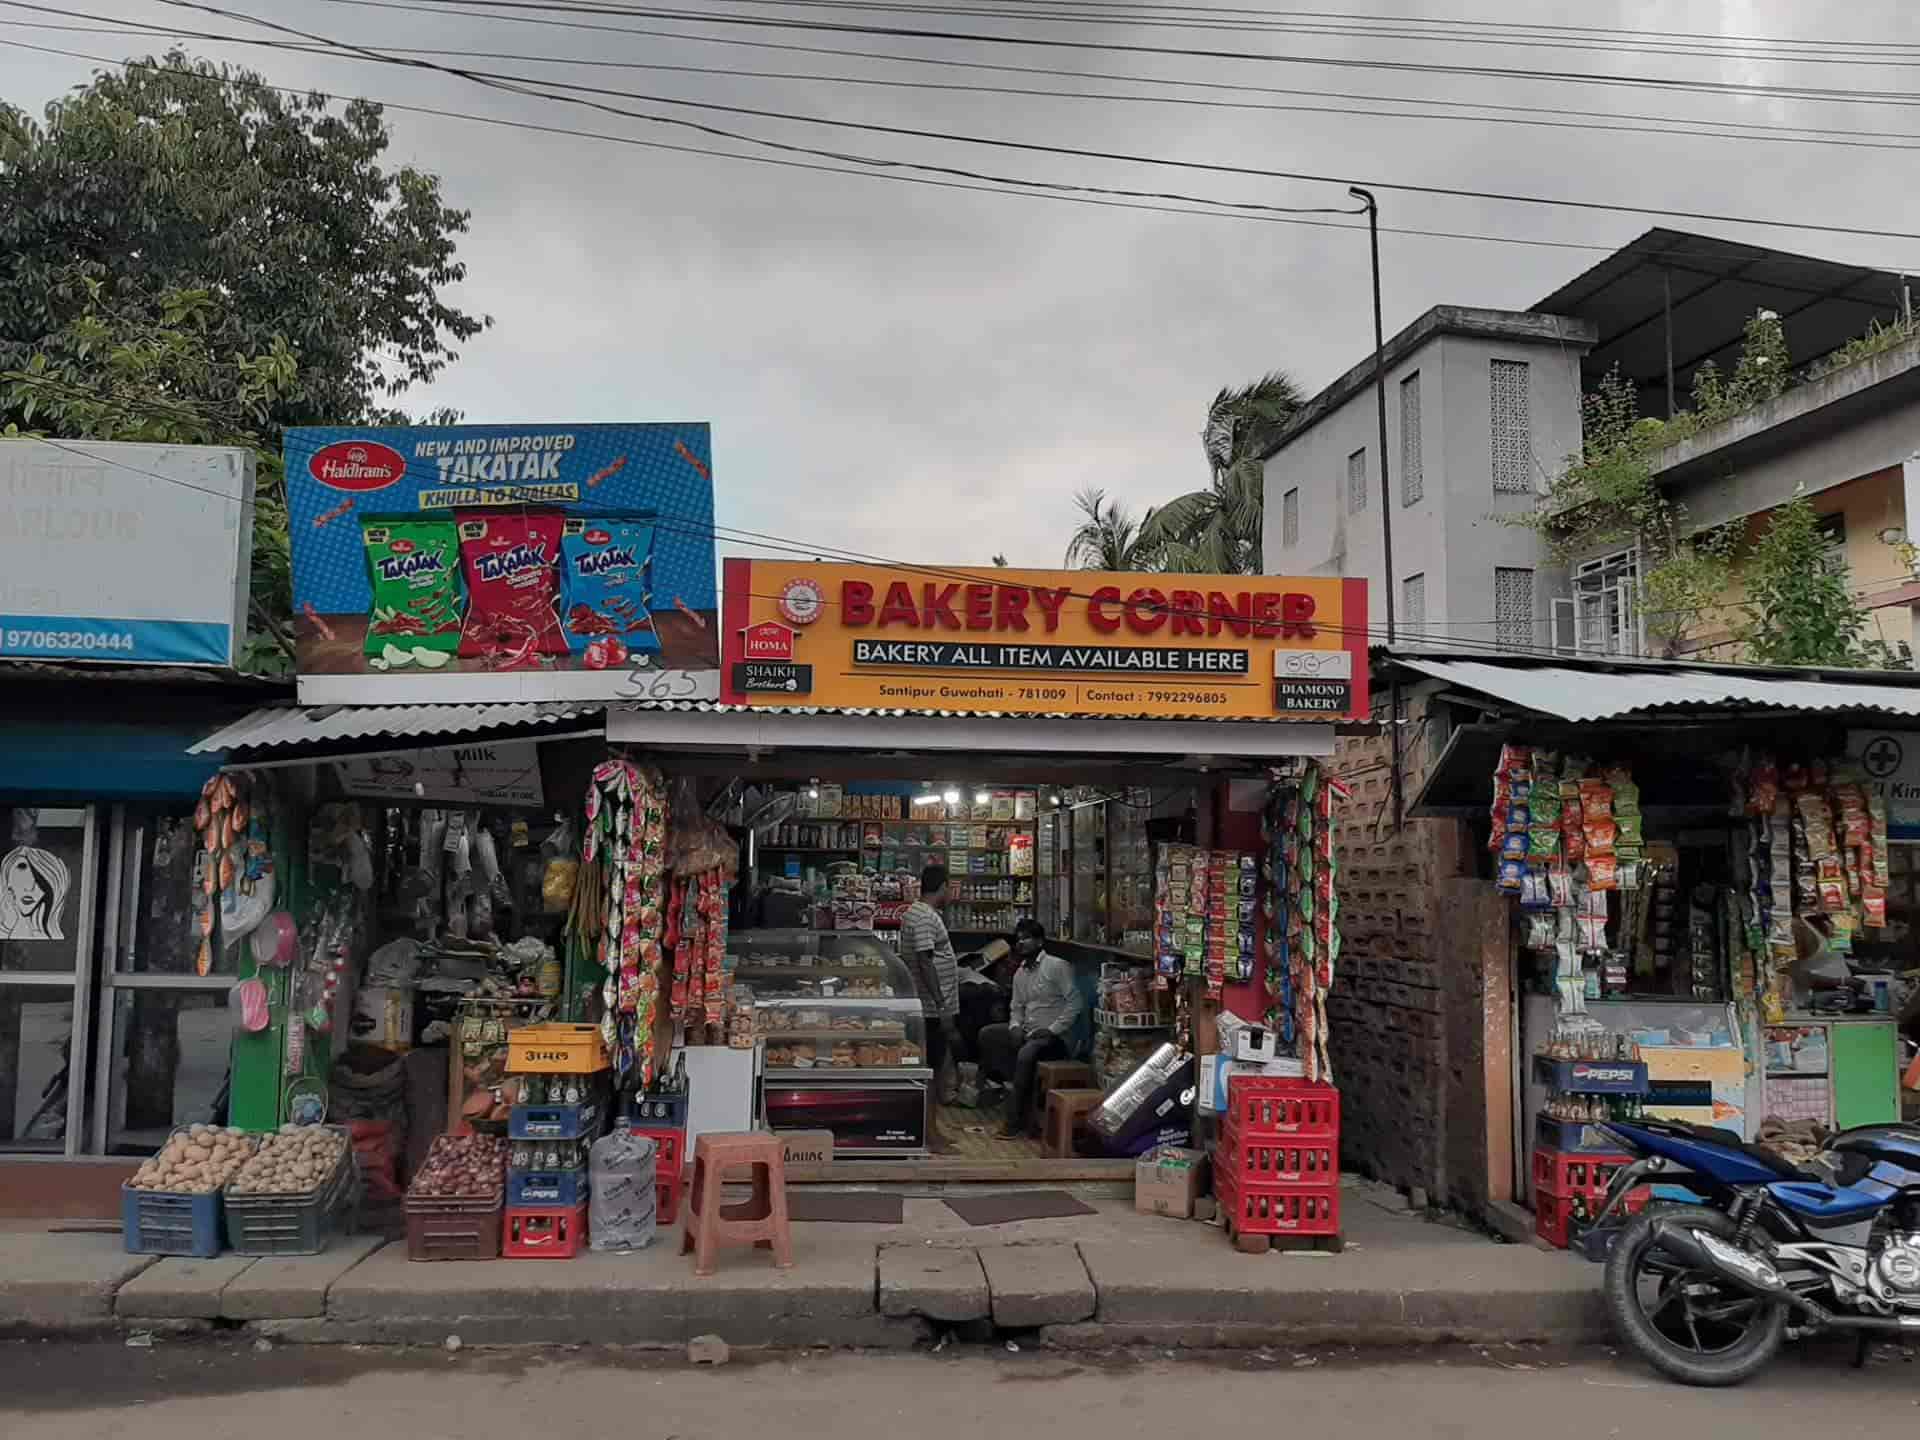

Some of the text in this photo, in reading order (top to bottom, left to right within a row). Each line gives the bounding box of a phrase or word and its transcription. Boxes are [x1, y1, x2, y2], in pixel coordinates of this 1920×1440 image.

[415, 435, 575, 457] NEW AND IMPROVED
[436, 453, 562, 485] TAKATAK
[424, 485, 576, 508] KHULLA TO KHALLAS
[841, 580, 1072, 634] BAKERY
[1087, 586, 1318, 640] CORNER
[8, 631, 134, 650] 9706320444
[857, 643, 1245, 671] BAKERY ALL ITEM AVAILABLE HERE
[746, 665, 796, 677] SHAIKH
[614, 670, 697, 698] 565
[879, 684, 938, 700] Santipur
[939, 685, 1004, 699] Guwahati
[1018, 687, 1067, 701] 781009
[1281, 684, 1345, 696] DIAMOND
[1087, 689, 1135, 702] Contact
[1147, 691, 1228, 705] 7992296805
[1286, 698, 1338, 709] BAKERY
